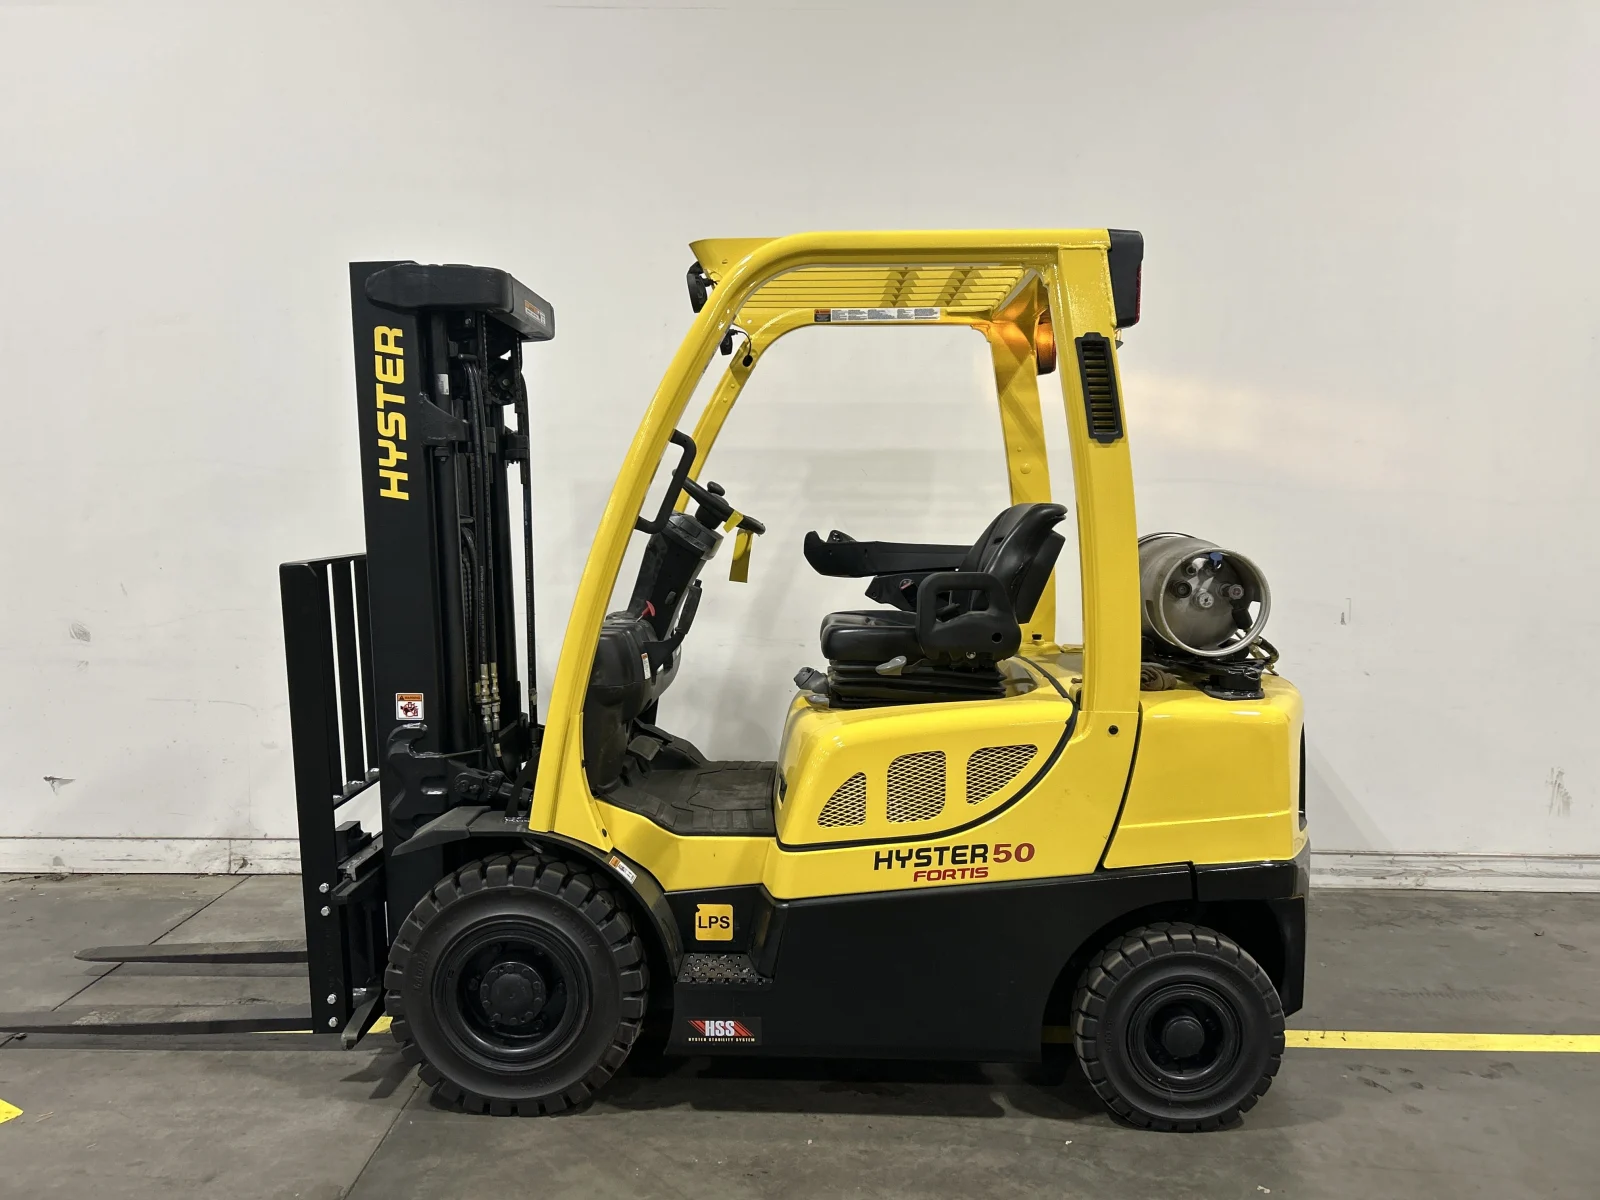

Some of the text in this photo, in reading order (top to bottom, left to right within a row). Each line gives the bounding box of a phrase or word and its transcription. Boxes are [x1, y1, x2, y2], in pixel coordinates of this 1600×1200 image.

[373, 325, 409, 501] HYSTER
[873, 842, 1036, 871] HYSTER 50
[913, 867, 989, 882] FORTIS
[698, 915, 730, 930] LPS
[704, 1020, 736, 1037] HSS
